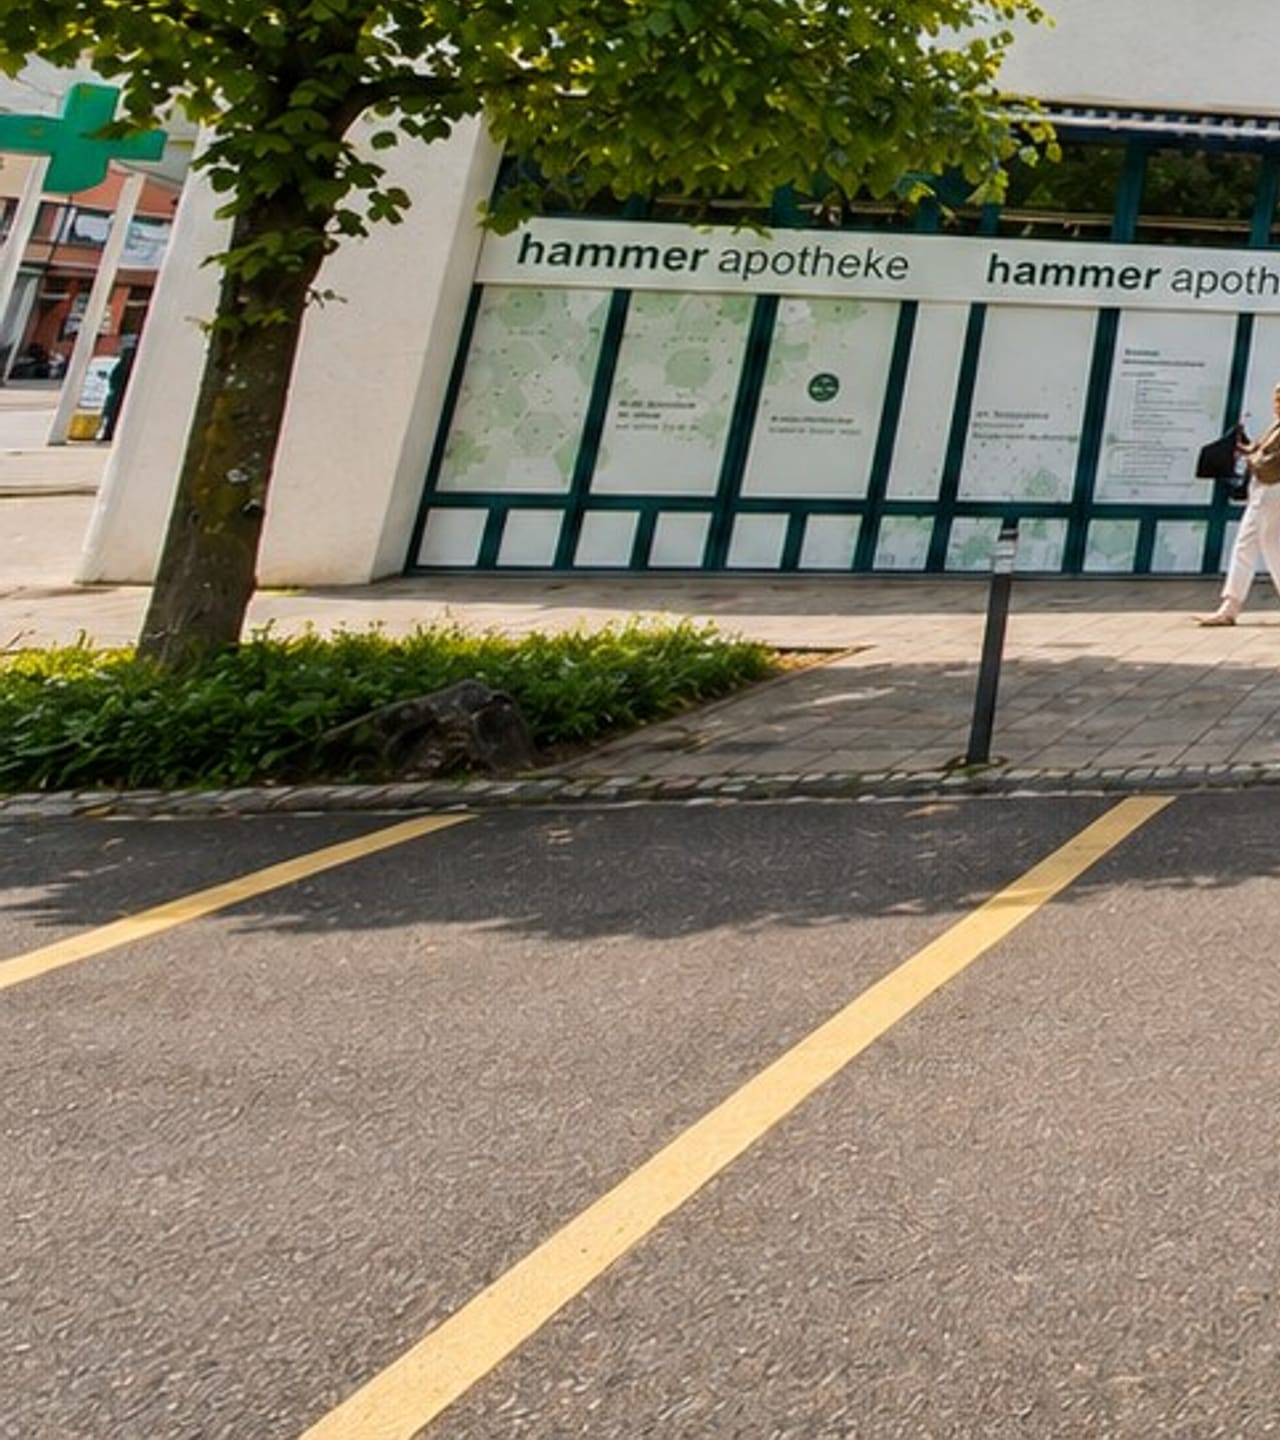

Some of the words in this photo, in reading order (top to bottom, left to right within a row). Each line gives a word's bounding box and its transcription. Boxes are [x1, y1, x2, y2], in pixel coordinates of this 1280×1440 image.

[517, 232, 707, 272] hammer
[718, 245, 909, 281] apotheke
[987, 253, 1160, 290] hammer
